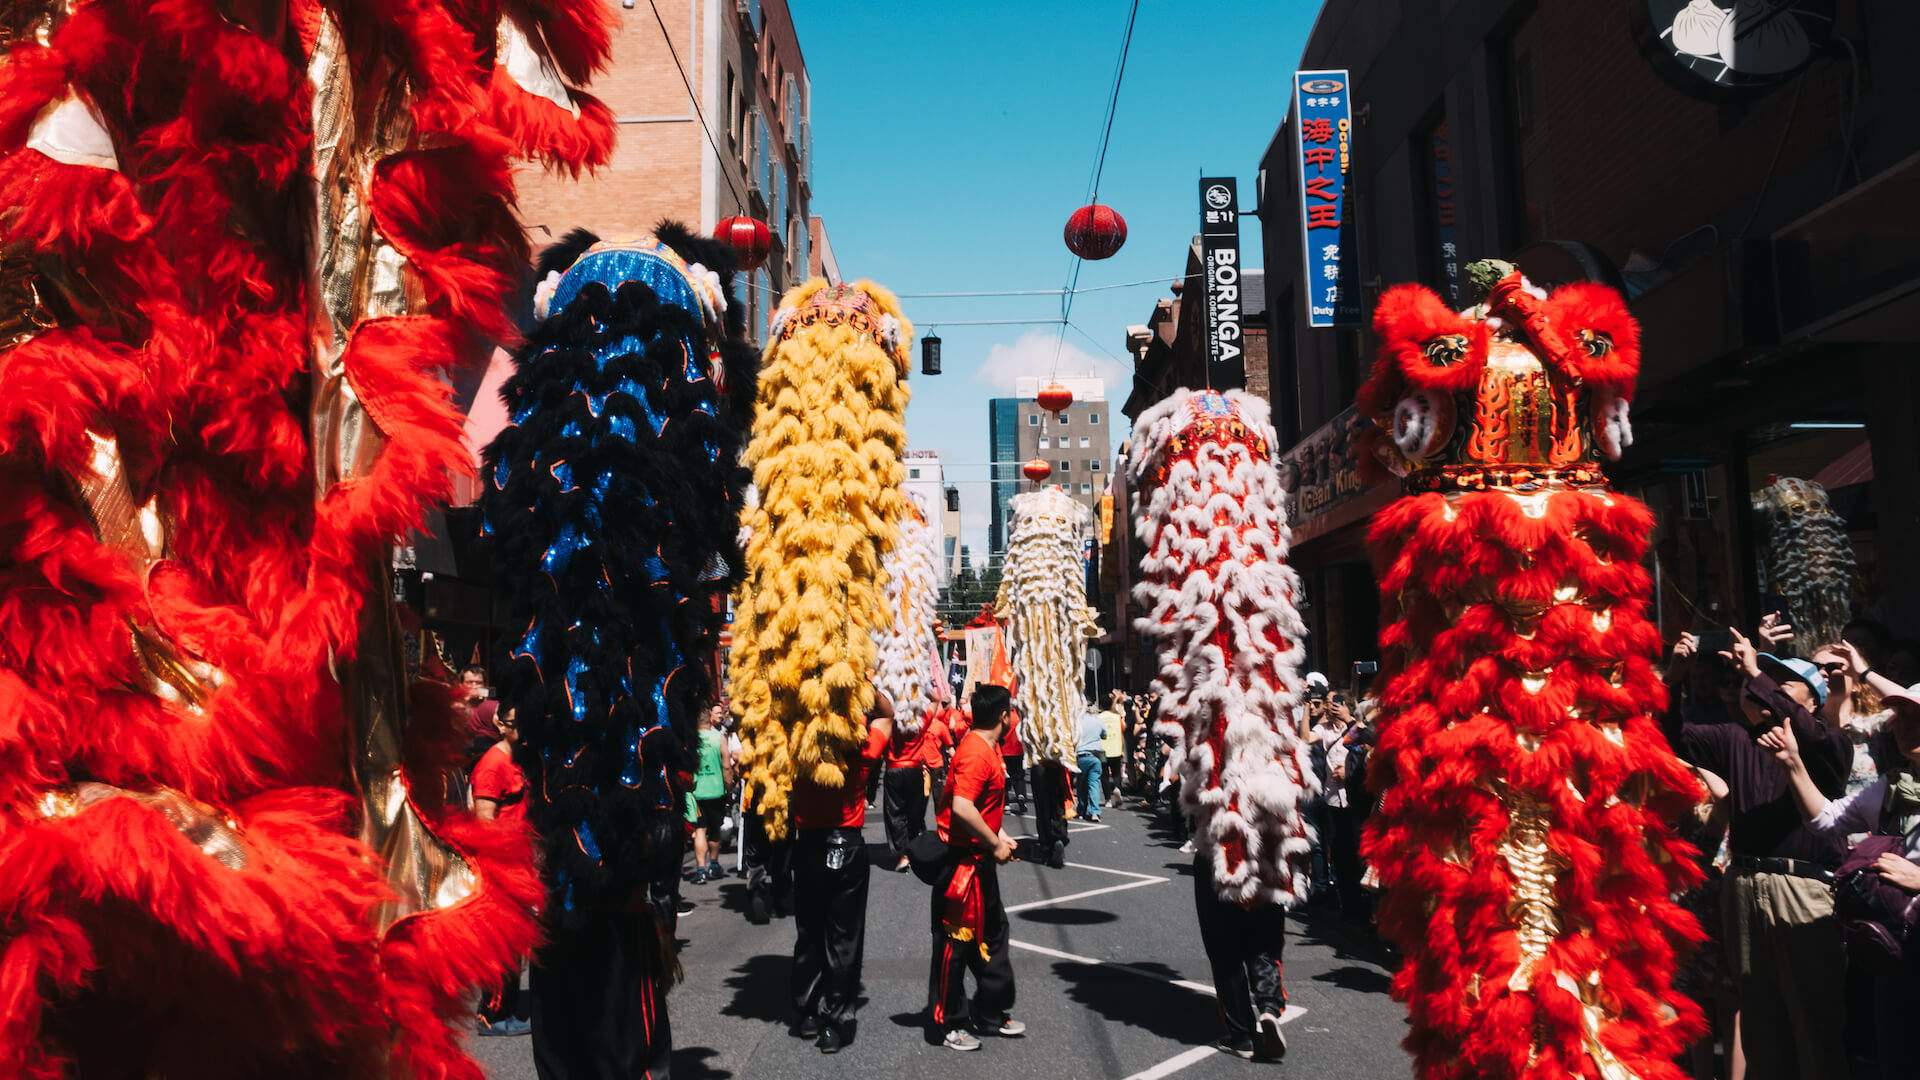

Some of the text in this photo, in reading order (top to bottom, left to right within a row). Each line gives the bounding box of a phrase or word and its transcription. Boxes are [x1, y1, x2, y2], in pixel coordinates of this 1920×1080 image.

[1303, 118, 1341, 228] 海中之王
[1206, 210, 1235, 223] 본가
[1209, 295, 1217, 328] KOREAN
[1214, 249, 1241, 362] BORNGA
[1313, 306, 1334, 317] Duty
[912, 450, 938, 459] HOTEL
